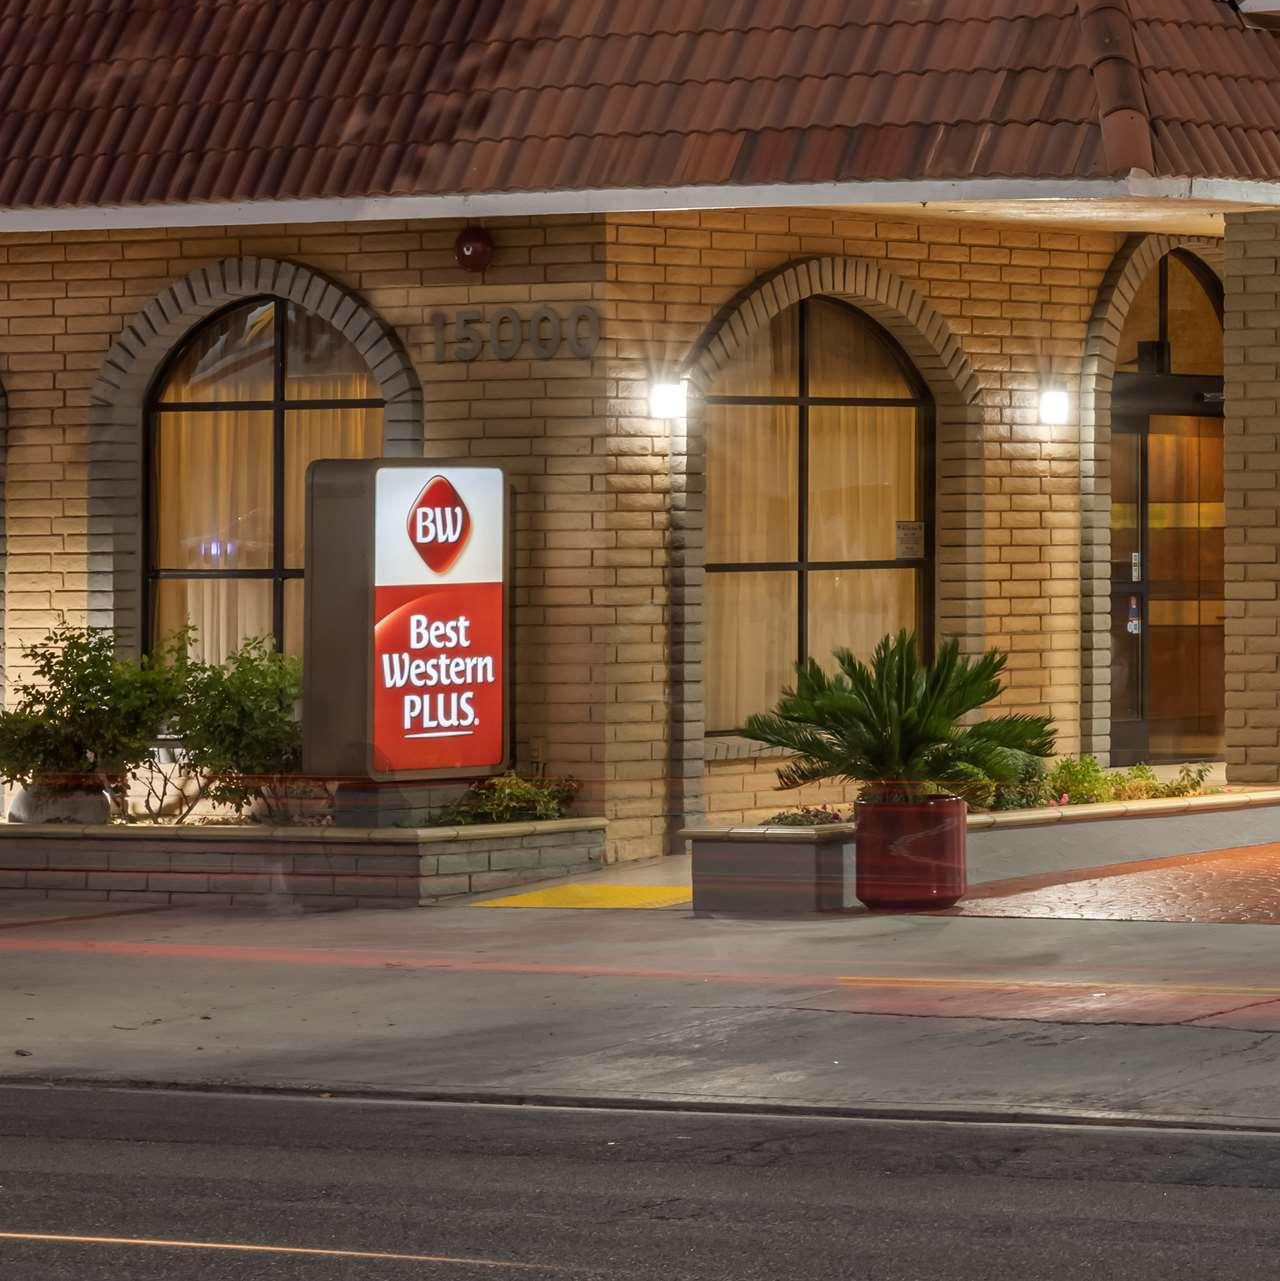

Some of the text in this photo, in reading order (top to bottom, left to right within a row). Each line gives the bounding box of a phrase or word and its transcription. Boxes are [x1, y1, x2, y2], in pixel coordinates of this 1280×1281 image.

[432, 304, 601, 365] 15000
[416, 506, 462, 545] BW
[409, 613, 471, 650] Best
[382, 652, 495, 689] Western
